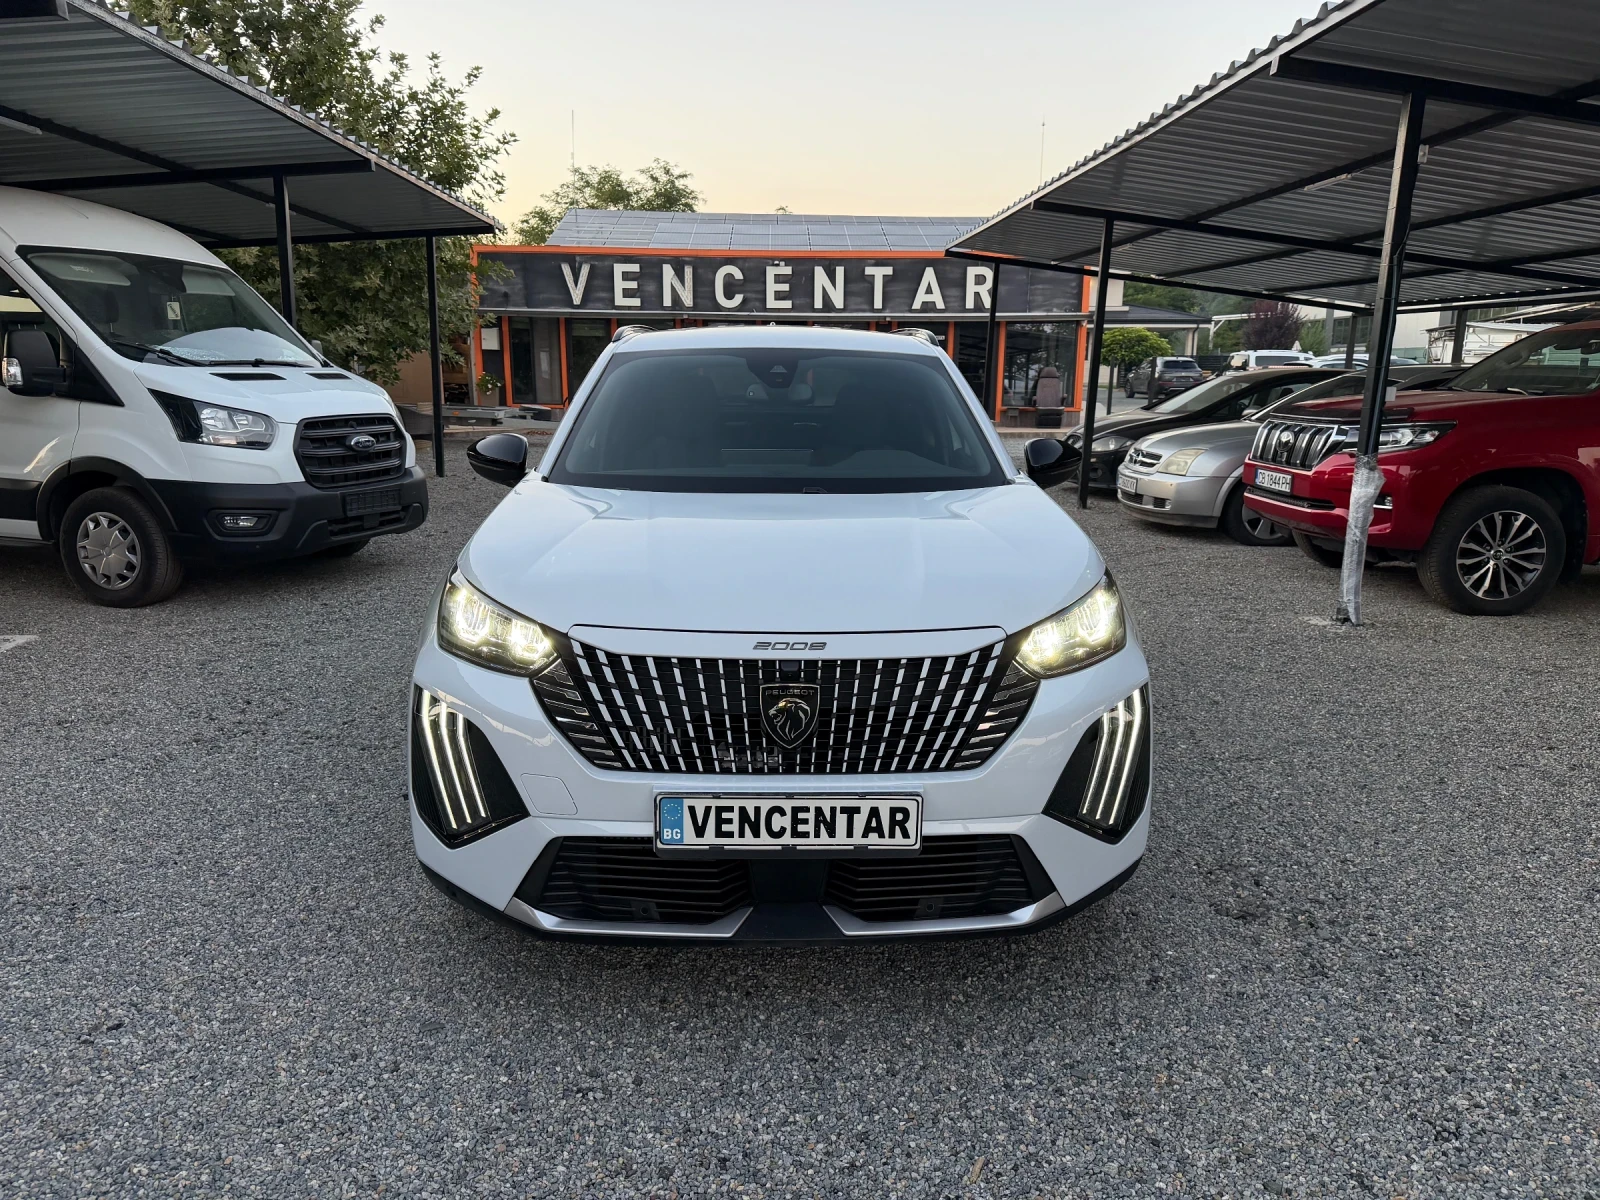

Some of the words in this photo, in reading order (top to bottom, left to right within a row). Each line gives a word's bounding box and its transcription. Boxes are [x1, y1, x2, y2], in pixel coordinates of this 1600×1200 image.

[561, 263, 993, 310] VENCENTAR
[752, 641, 827, 651] 2008
[663, 828, 681, 840] BG
[687, 805, 911, 840] VENCENTAR
